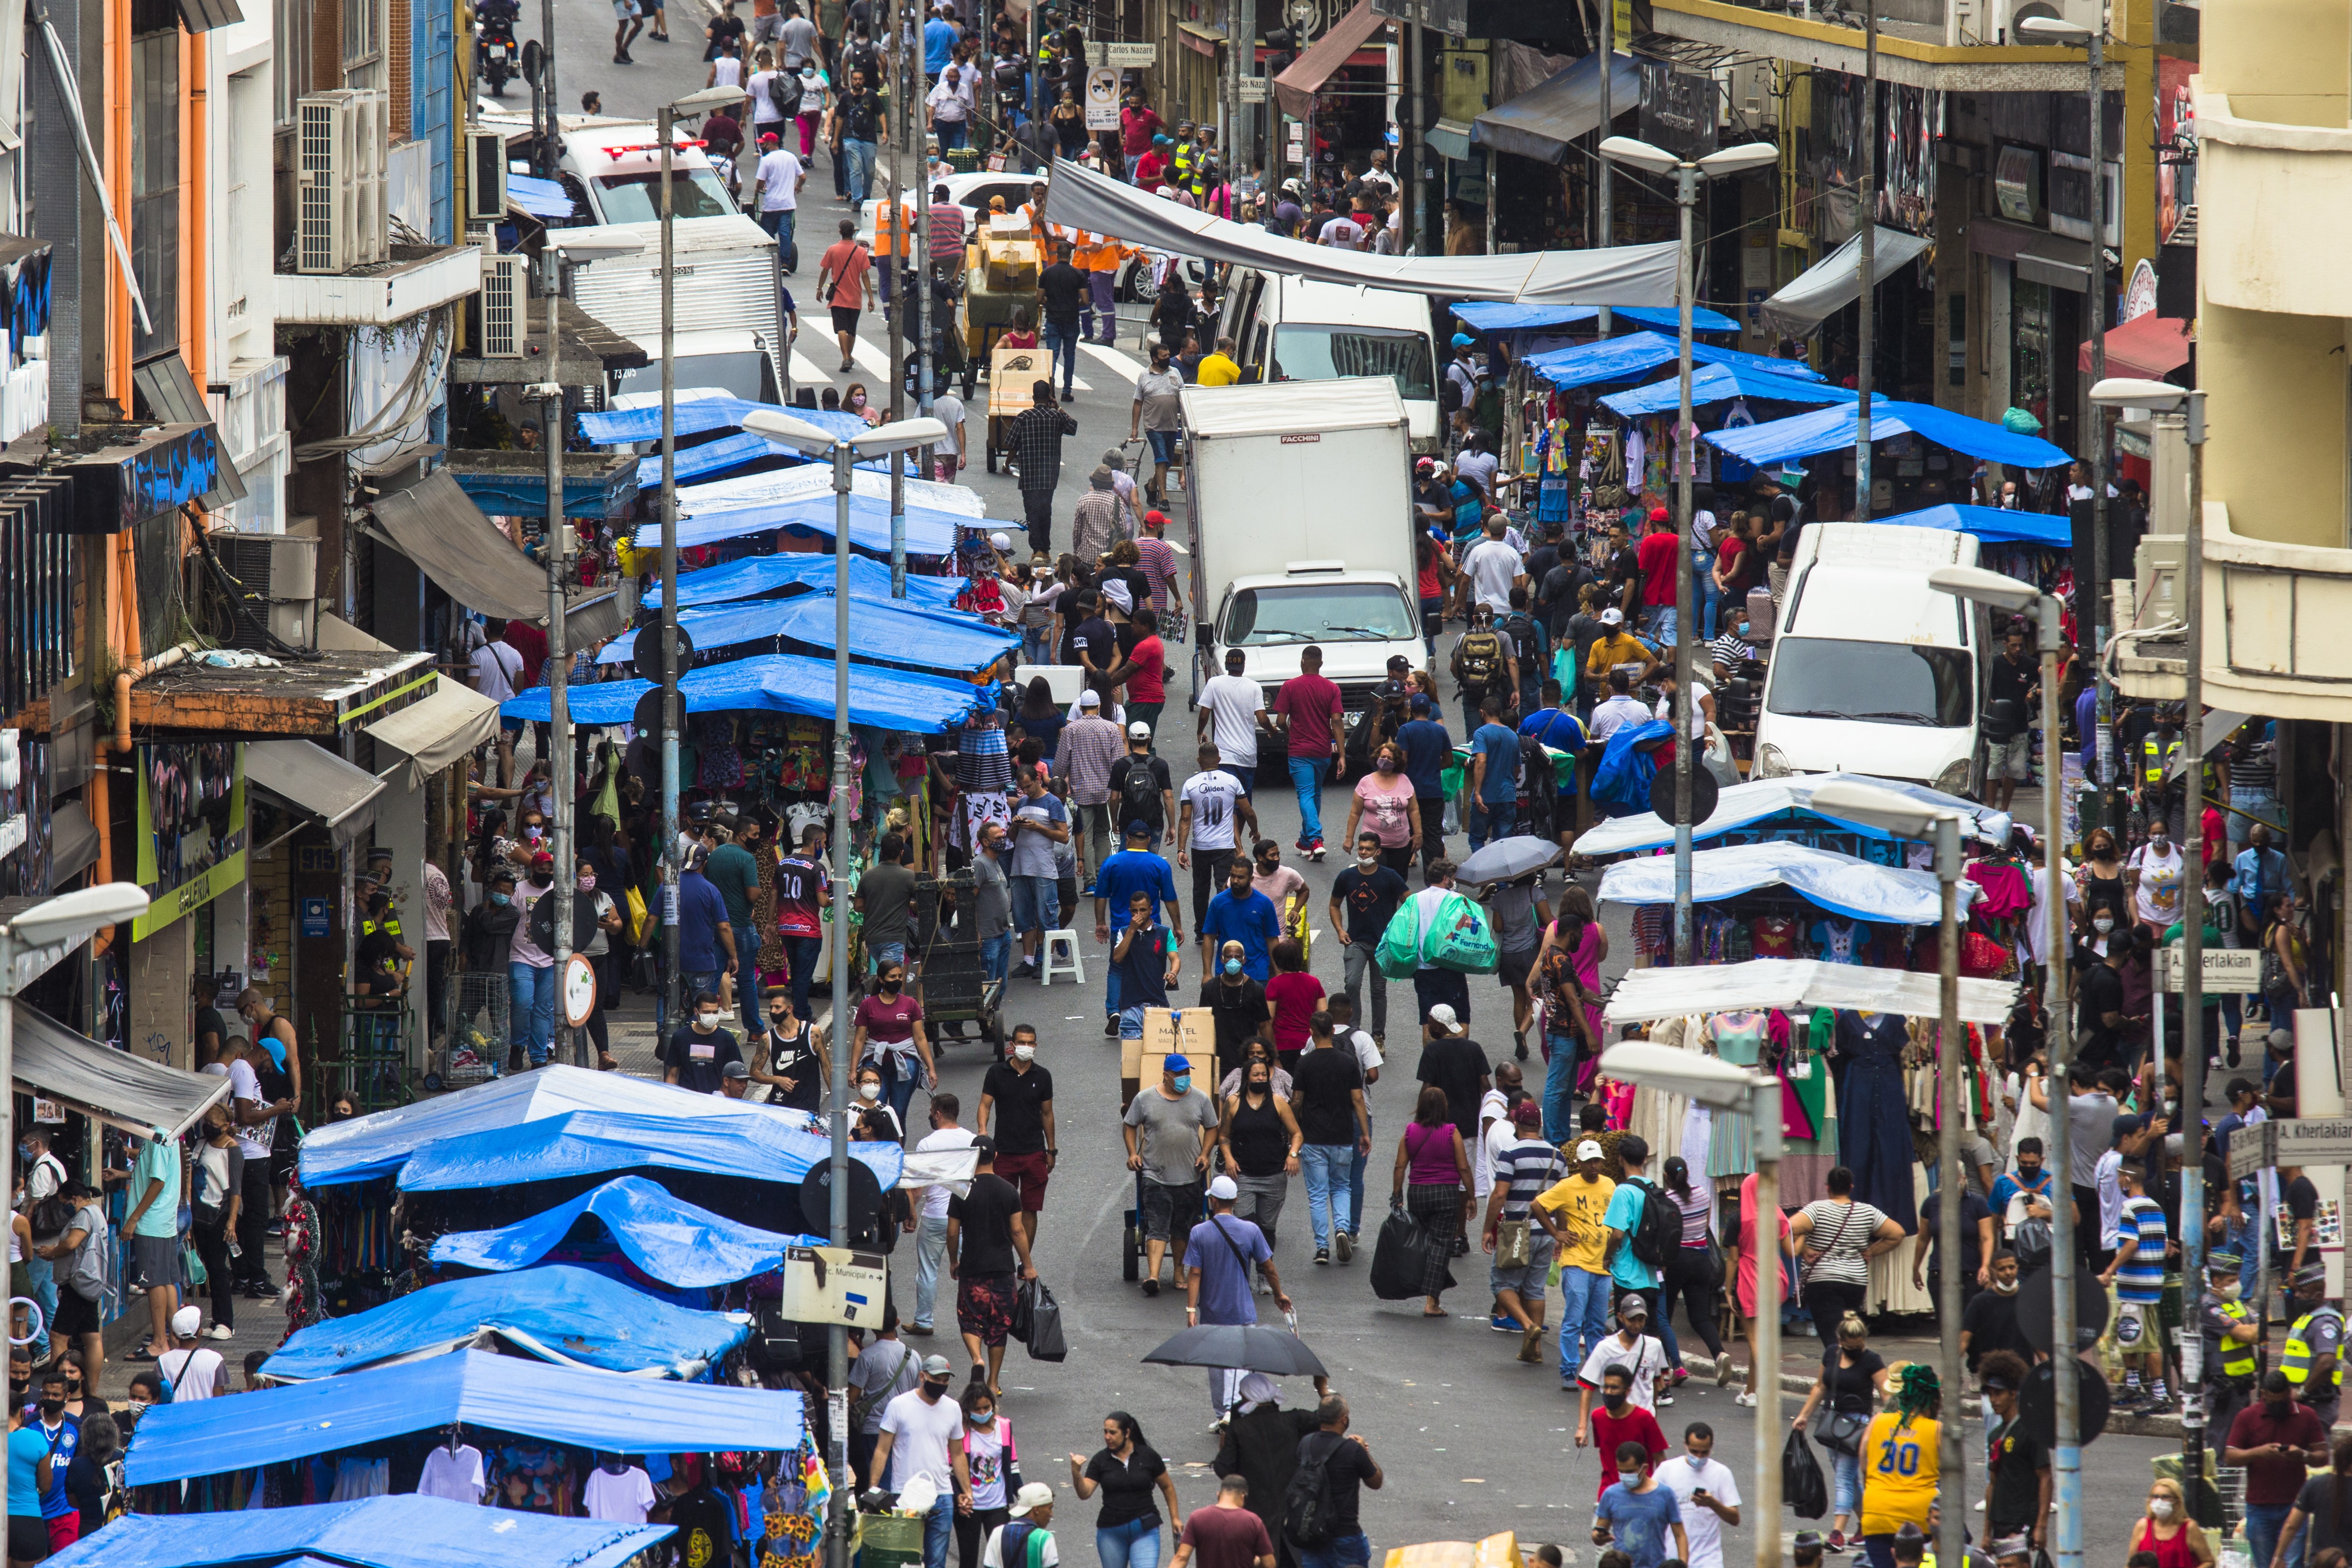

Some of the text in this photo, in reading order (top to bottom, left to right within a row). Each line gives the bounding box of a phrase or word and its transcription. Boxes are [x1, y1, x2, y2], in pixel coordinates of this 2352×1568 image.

[1109, 45, 1153, 54] Carlos Nazaré
[1250, 80, 1266, 89] Naza
[654, 267, 692, 277] RDON
[1282, 435, 1319, 443] FACCHINI
[1200, 783, 1225, 794] Midea
[1202, 797, 1223, 826] 10
[302, 848, 336, 870] 915
[783, 873, 801, 899] 10
[179, 874, 210, 914] GALERIA
[2202, 953, 2251, 968] erlakian
[1513, 1227, 1522, 1258] adidas
[835, 1268, 867, 1280] Municipal
[1878, 1440, 1920, 1477] 30
